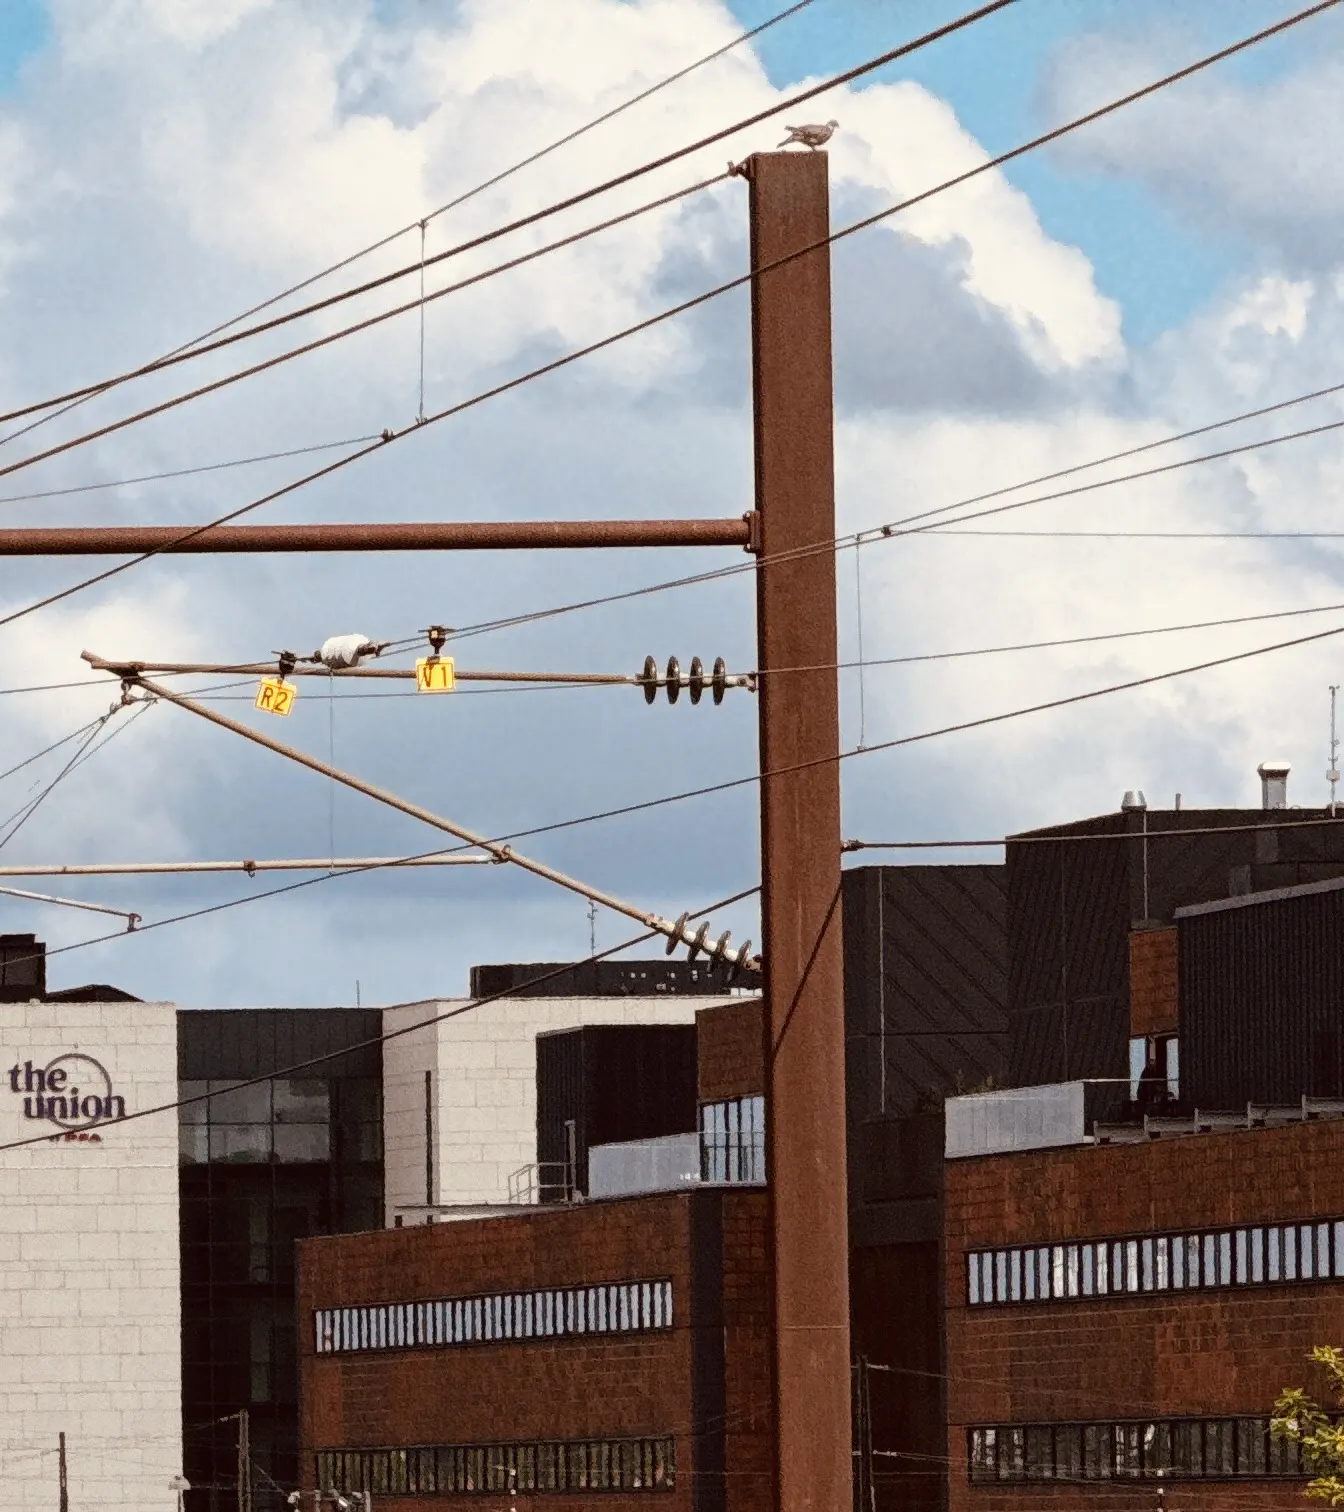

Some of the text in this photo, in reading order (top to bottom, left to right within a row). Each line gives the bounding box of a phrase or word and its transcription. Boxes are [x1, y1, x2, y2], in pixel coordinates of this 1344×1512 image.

[260, 686, 289, 712] R2
[8, 1060, 67, 1092] the
[24, 1087, 126, 1119] union
